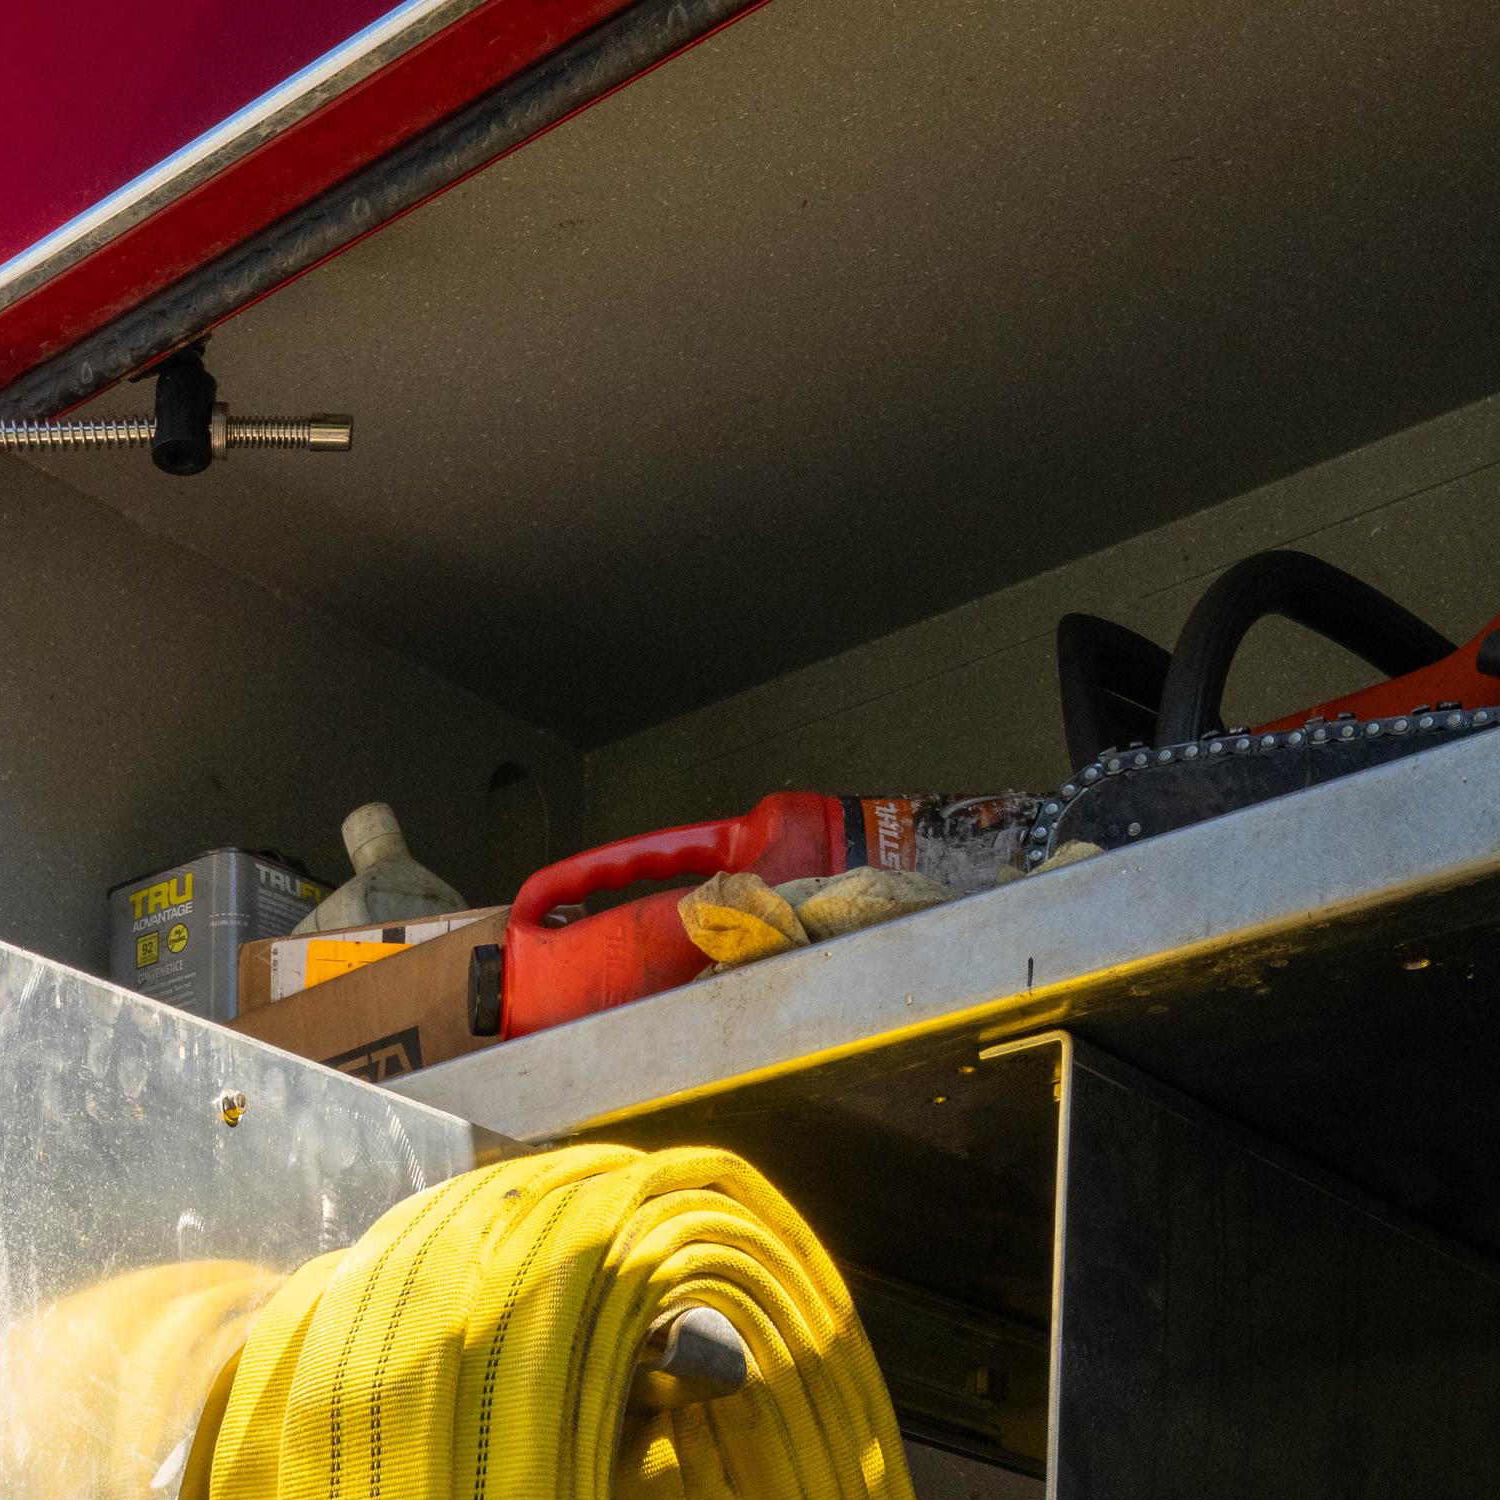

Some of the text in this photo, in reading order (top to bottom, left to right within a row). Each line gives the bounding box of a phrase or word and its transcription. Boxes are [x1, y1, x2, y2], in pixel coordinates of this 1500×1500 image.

[129, 872, 194, 920] TRU
[132, 902, 193, 933] ADVANTAGE
[142, 942, 154, 956] 92
